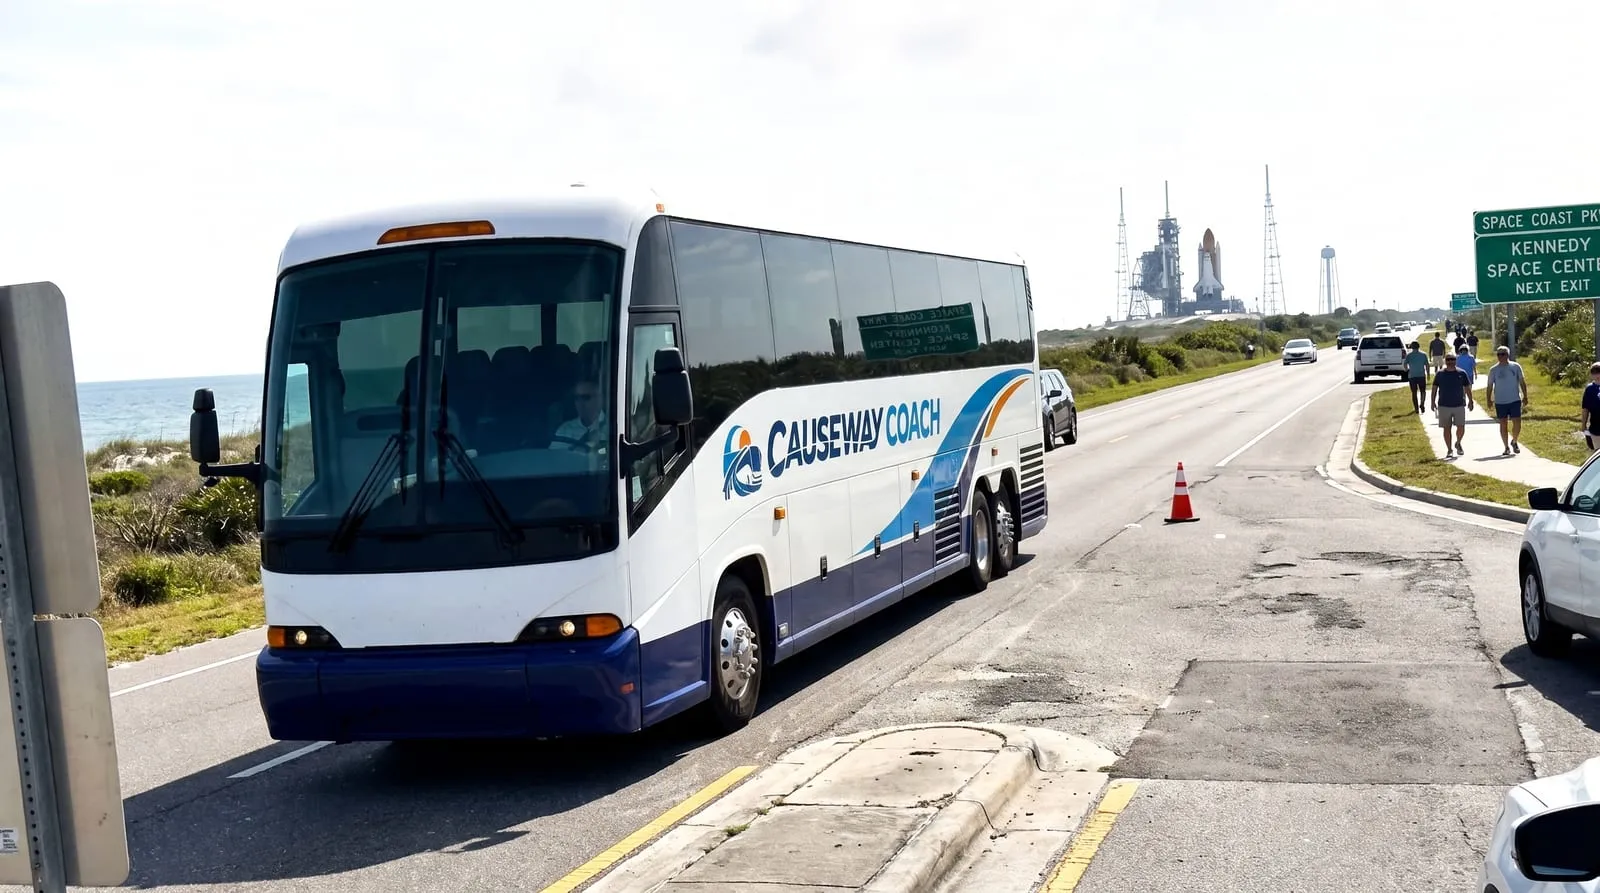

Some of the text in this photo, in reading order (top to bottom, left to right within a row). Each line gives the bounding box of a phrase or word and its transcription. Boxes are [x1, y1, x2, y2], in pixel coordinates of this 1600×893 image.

[1482, 209, 1600, 229] SPACE COAST PK
[1511, 237, 1591, 256] KENNEDY
[1487, 261, 1542, 278] SPACE
[1516, 279, 1590, 295] NEXT EXIT
[767, 398, 941, 478] CAUSEWAY COACH
